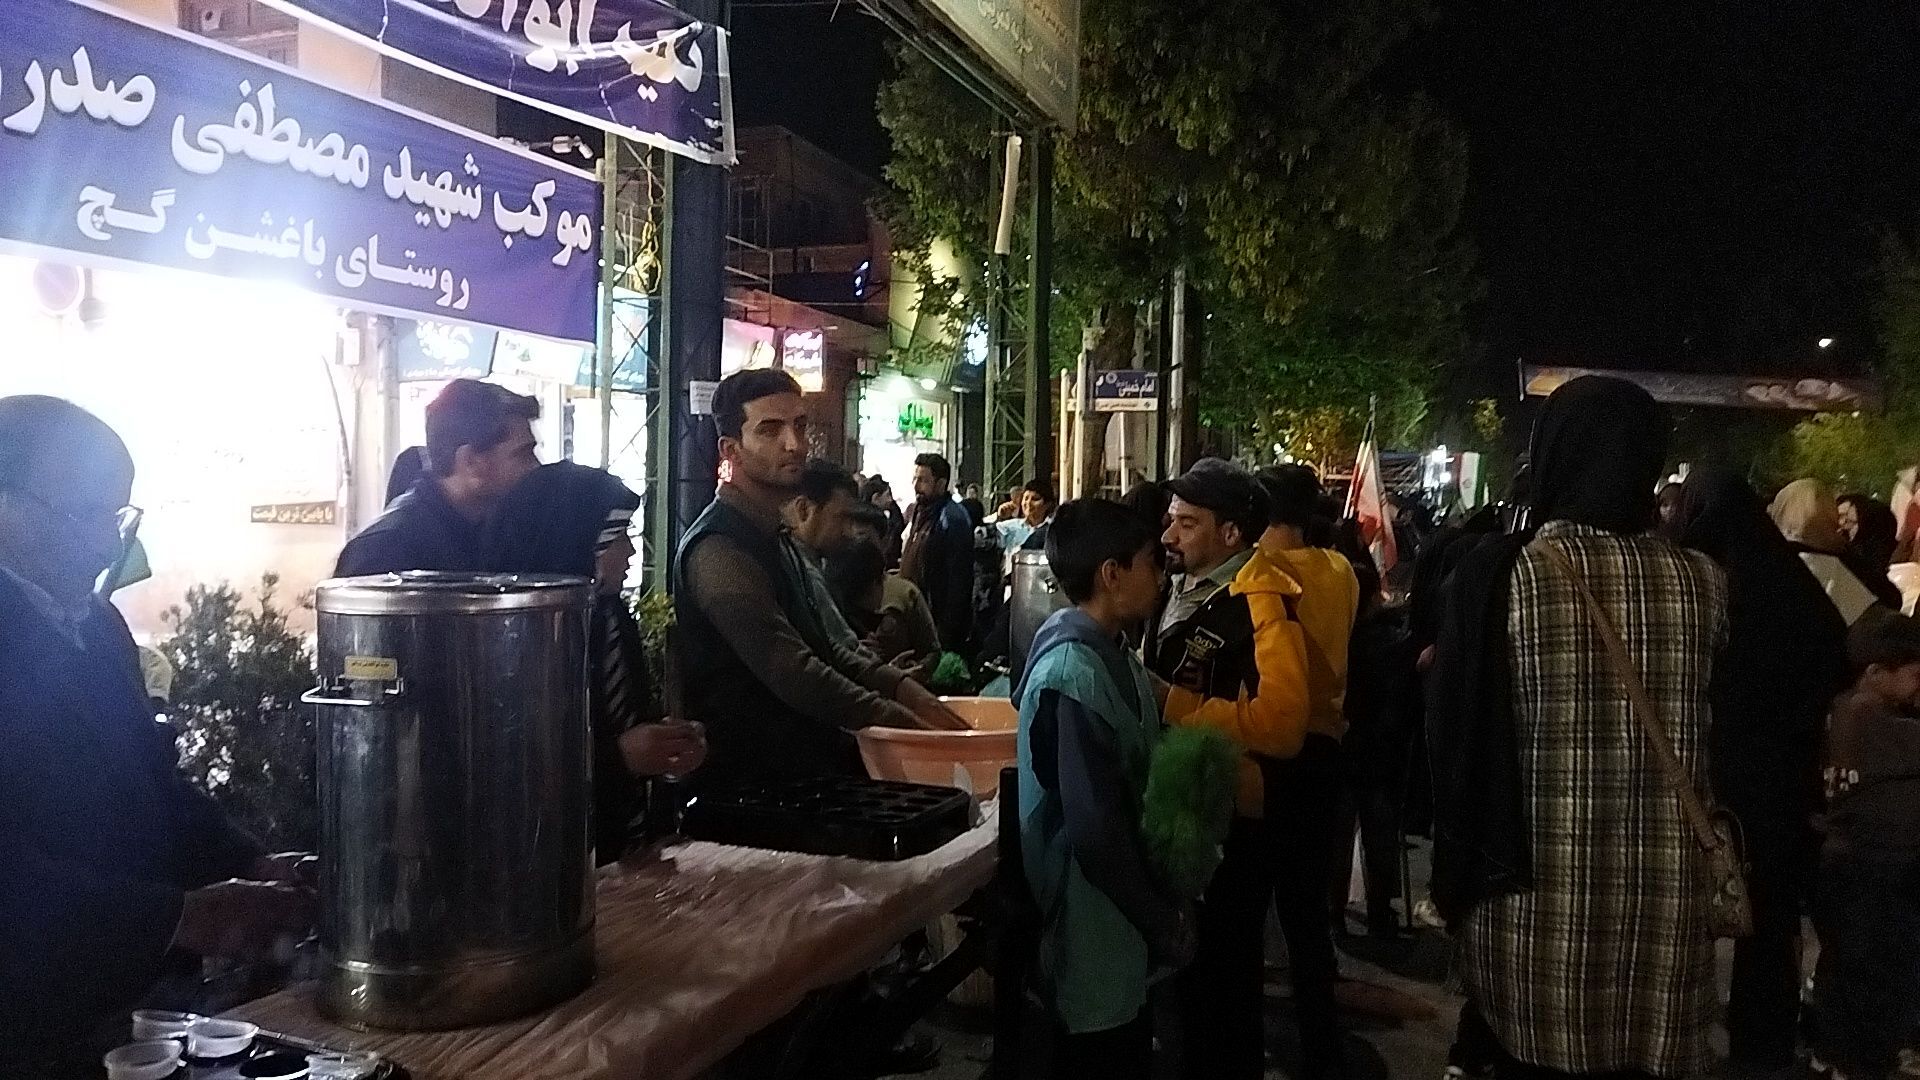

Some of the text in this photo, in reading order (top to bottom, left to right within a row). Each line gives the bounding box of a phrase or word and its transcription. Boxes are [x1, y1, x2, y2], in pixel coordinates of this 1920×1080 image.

[0, 45, 592, 267] موکب شهید مصطفی صدر
[184, 205, 326, 267] باغشن
[335, 234, 470, 310] روستای
